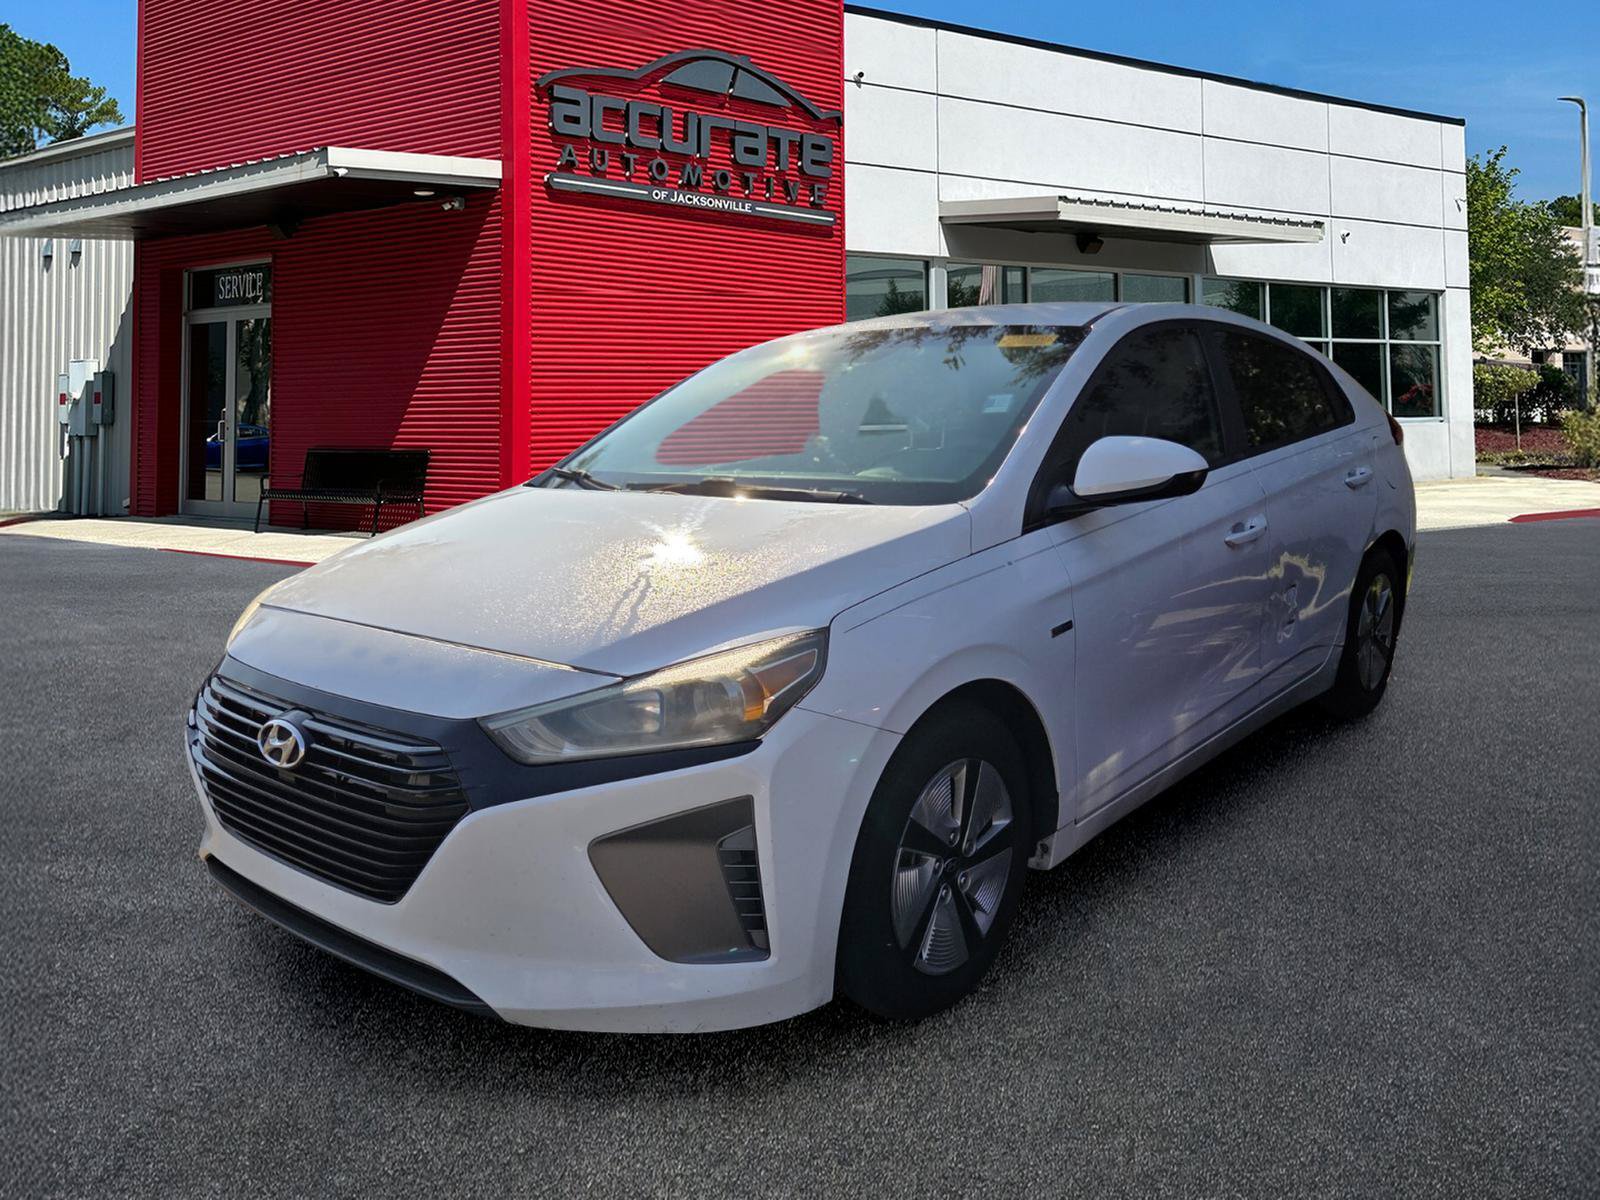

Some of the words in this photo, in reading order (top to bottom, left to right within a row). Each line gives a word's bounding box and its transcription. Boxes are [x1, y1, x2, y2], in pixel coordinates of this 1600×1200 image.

[560, 143, 829, 205] AUTOMOTIVE
[652, 189, 669, 200] OF
[218, 272, 264, 300] SERVICE
